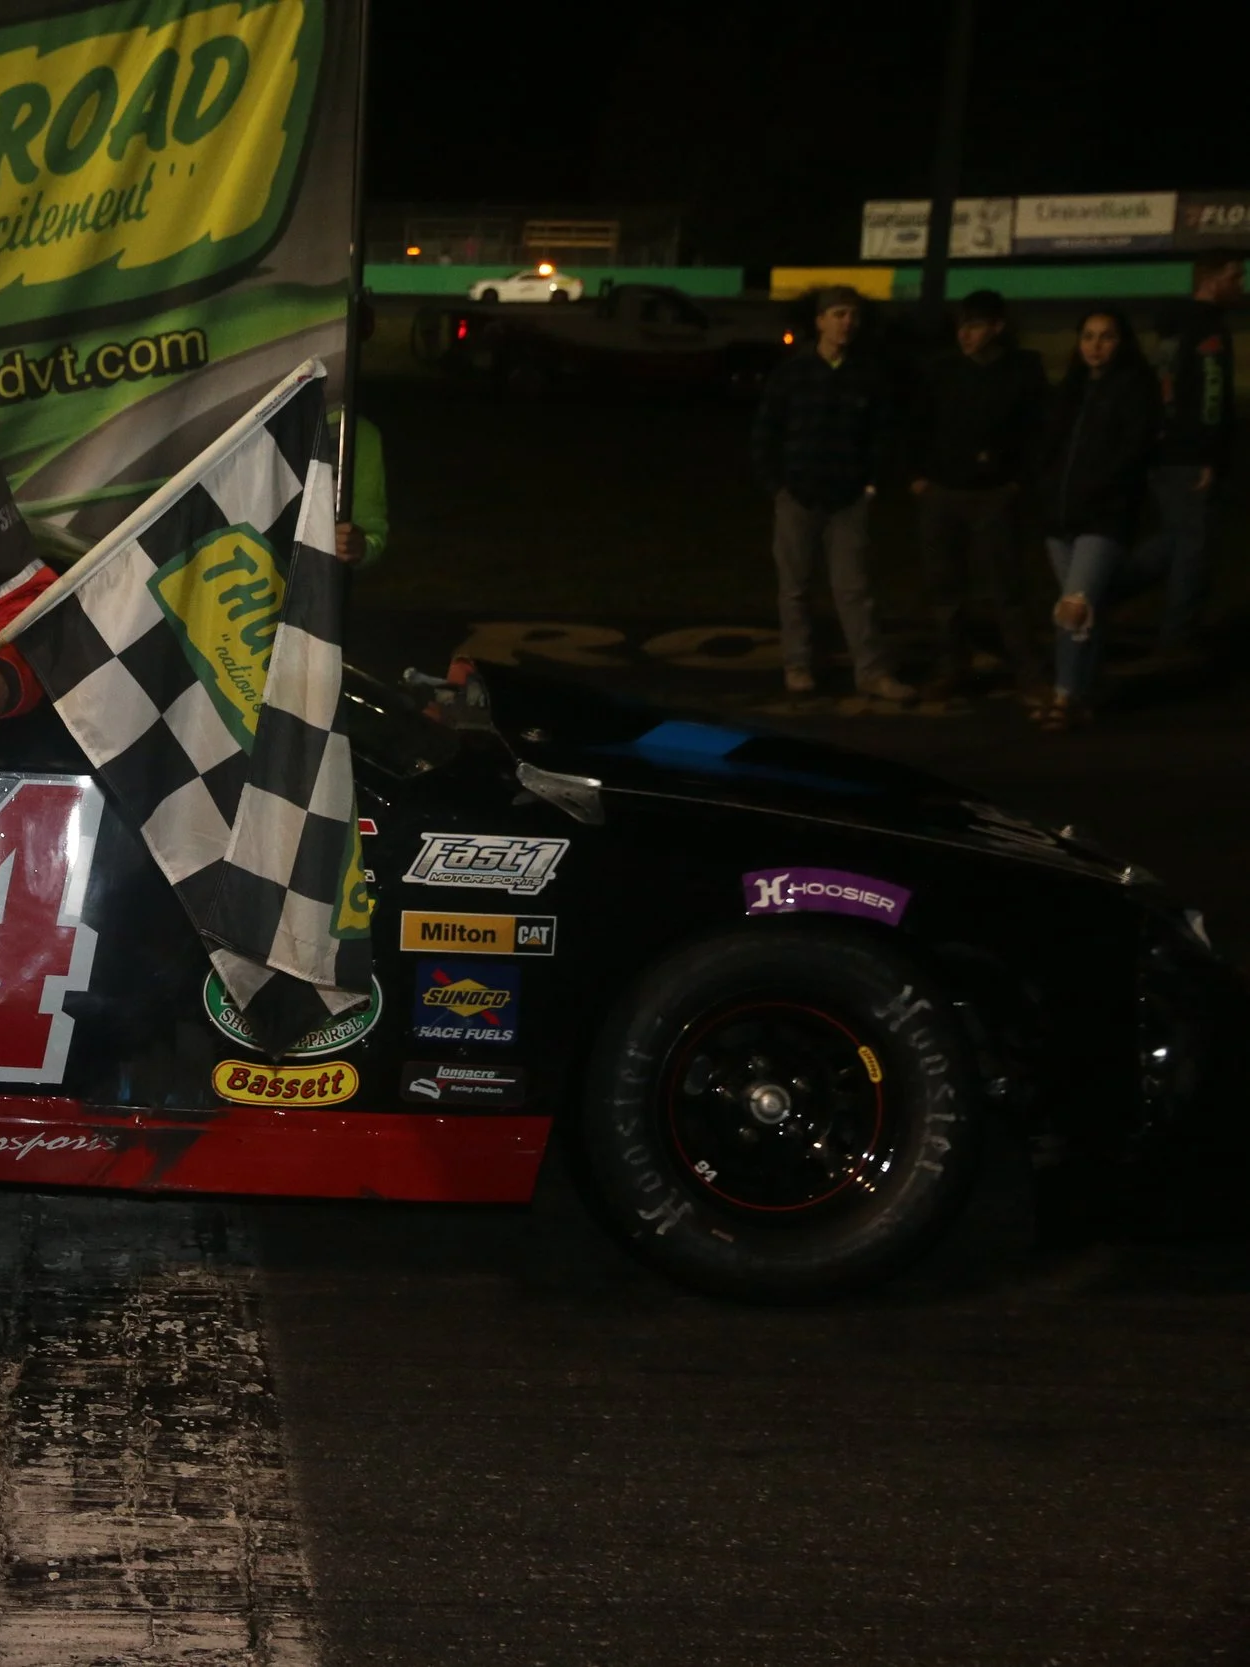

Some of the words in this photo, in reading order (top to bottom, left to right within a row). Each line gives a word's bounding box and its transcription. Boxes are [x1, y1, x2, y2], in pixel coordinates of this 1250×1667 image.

[428, 871, 545, 887] MOTORSPORTS
[790, 882, 896, 913] HOOSIER
[421, 922, 497, 944] Milton
[517, 925, 551, 946] CAT
[426, 989, 509, 1007] SUNOCO
[418, 1026, 464, 1039] RACE
[464, 1027, 514, 1042] FUELS
[436, 1065, 496, 1079] Longacre
[226, 1067, 344, 1100] Bassett
